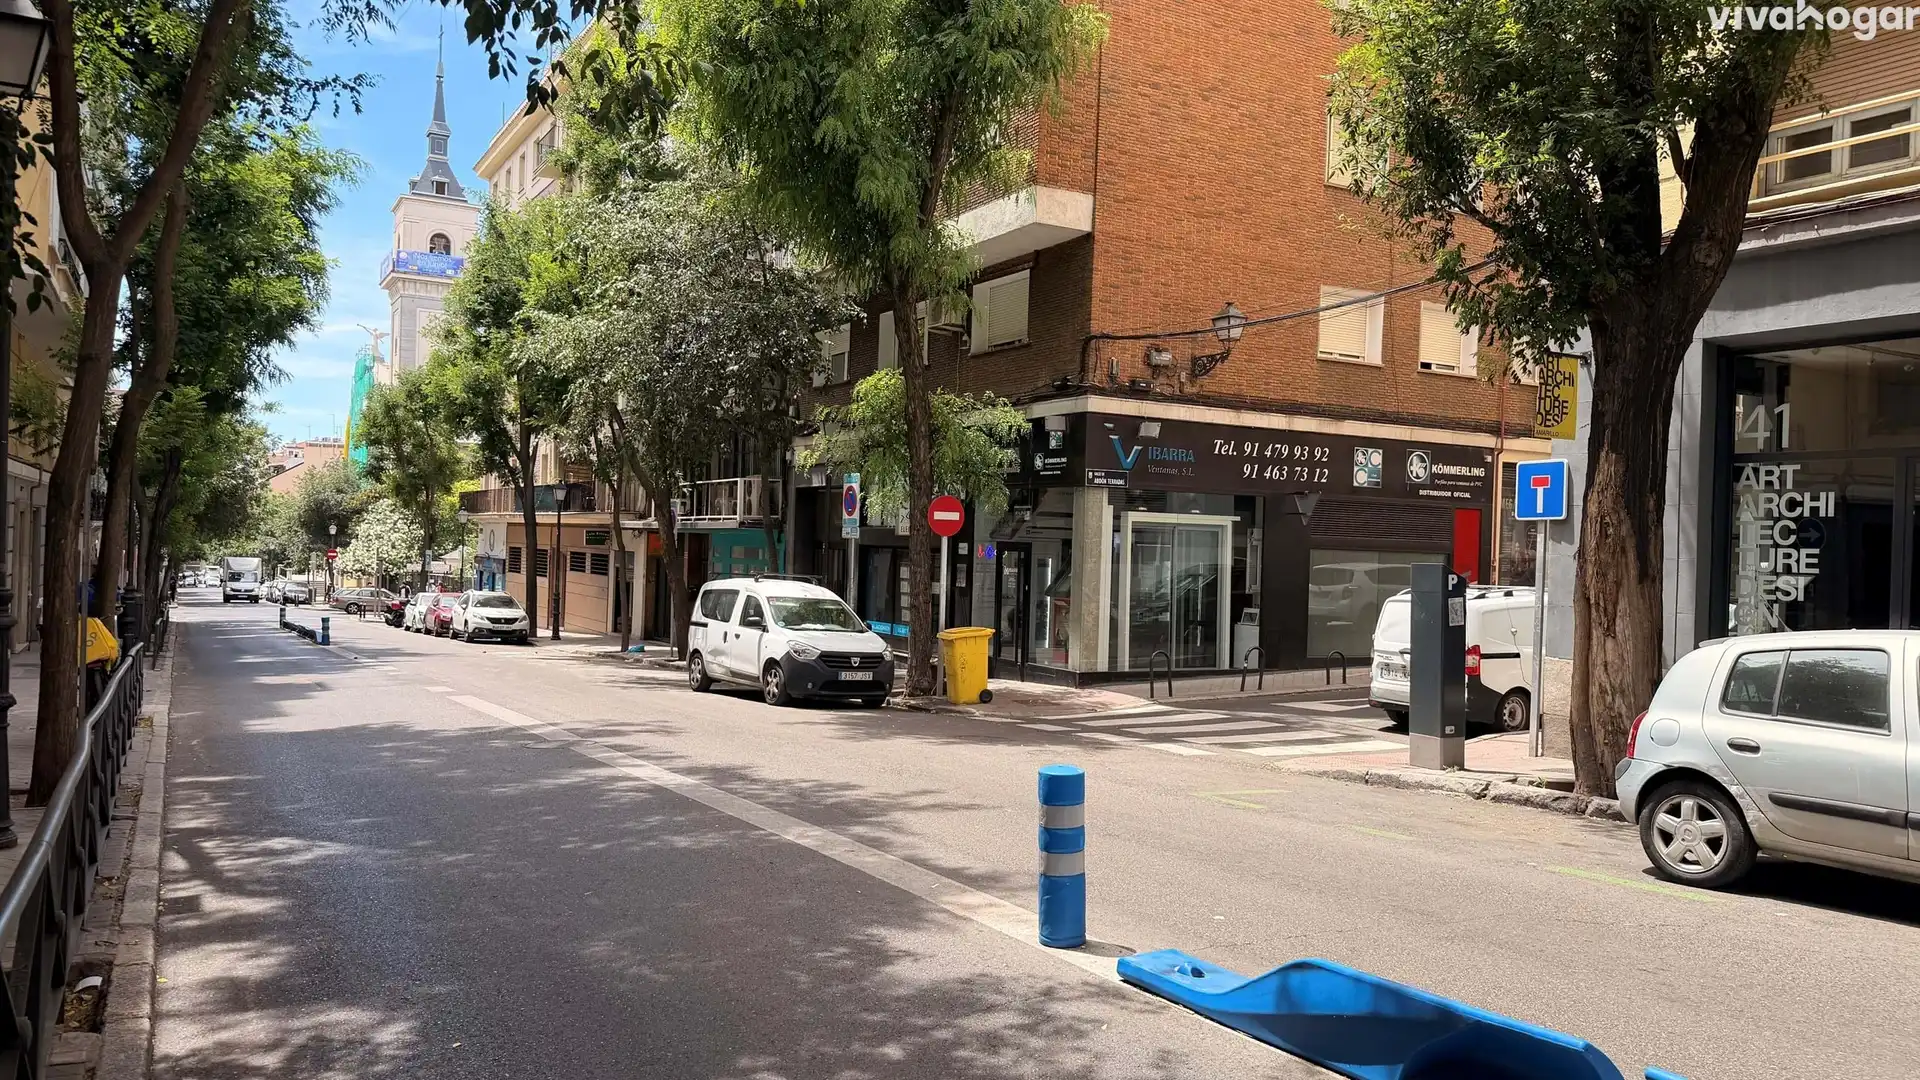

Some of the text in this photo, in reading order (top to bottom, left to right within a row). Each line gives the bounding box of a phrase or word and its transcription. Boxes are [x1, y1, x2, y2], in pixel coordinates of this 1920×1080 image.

[1539, 367, 1575, 387] ARCHI
[1538, 383, 1561, 399] TEC
[1537, 397, 1569, 415] TURE
[1742, 402, 1791, 450] 41
[1148, 446, 1195, 463] IBARRA
[1213, 439, 1330, 462] Tel. 91 479 93 92
[1147, 465, 1180, 475] Ventanas,
[1243, 463, 1329, 483] 91 463 73 12
[1431, 463, 1486, 477] KÖMMERLING
[1736, 464, 1801, 490] ART
[1736, 491, 1835, 518] ARCHI
[1736, 518, 1797, 546] TEC
[1735, 547, 1820, 574] TURE
[1448, 574, 1458, 591] P
[1736, 575, 1805, 602] DESI
[843, 672, 857, 680] 3157
